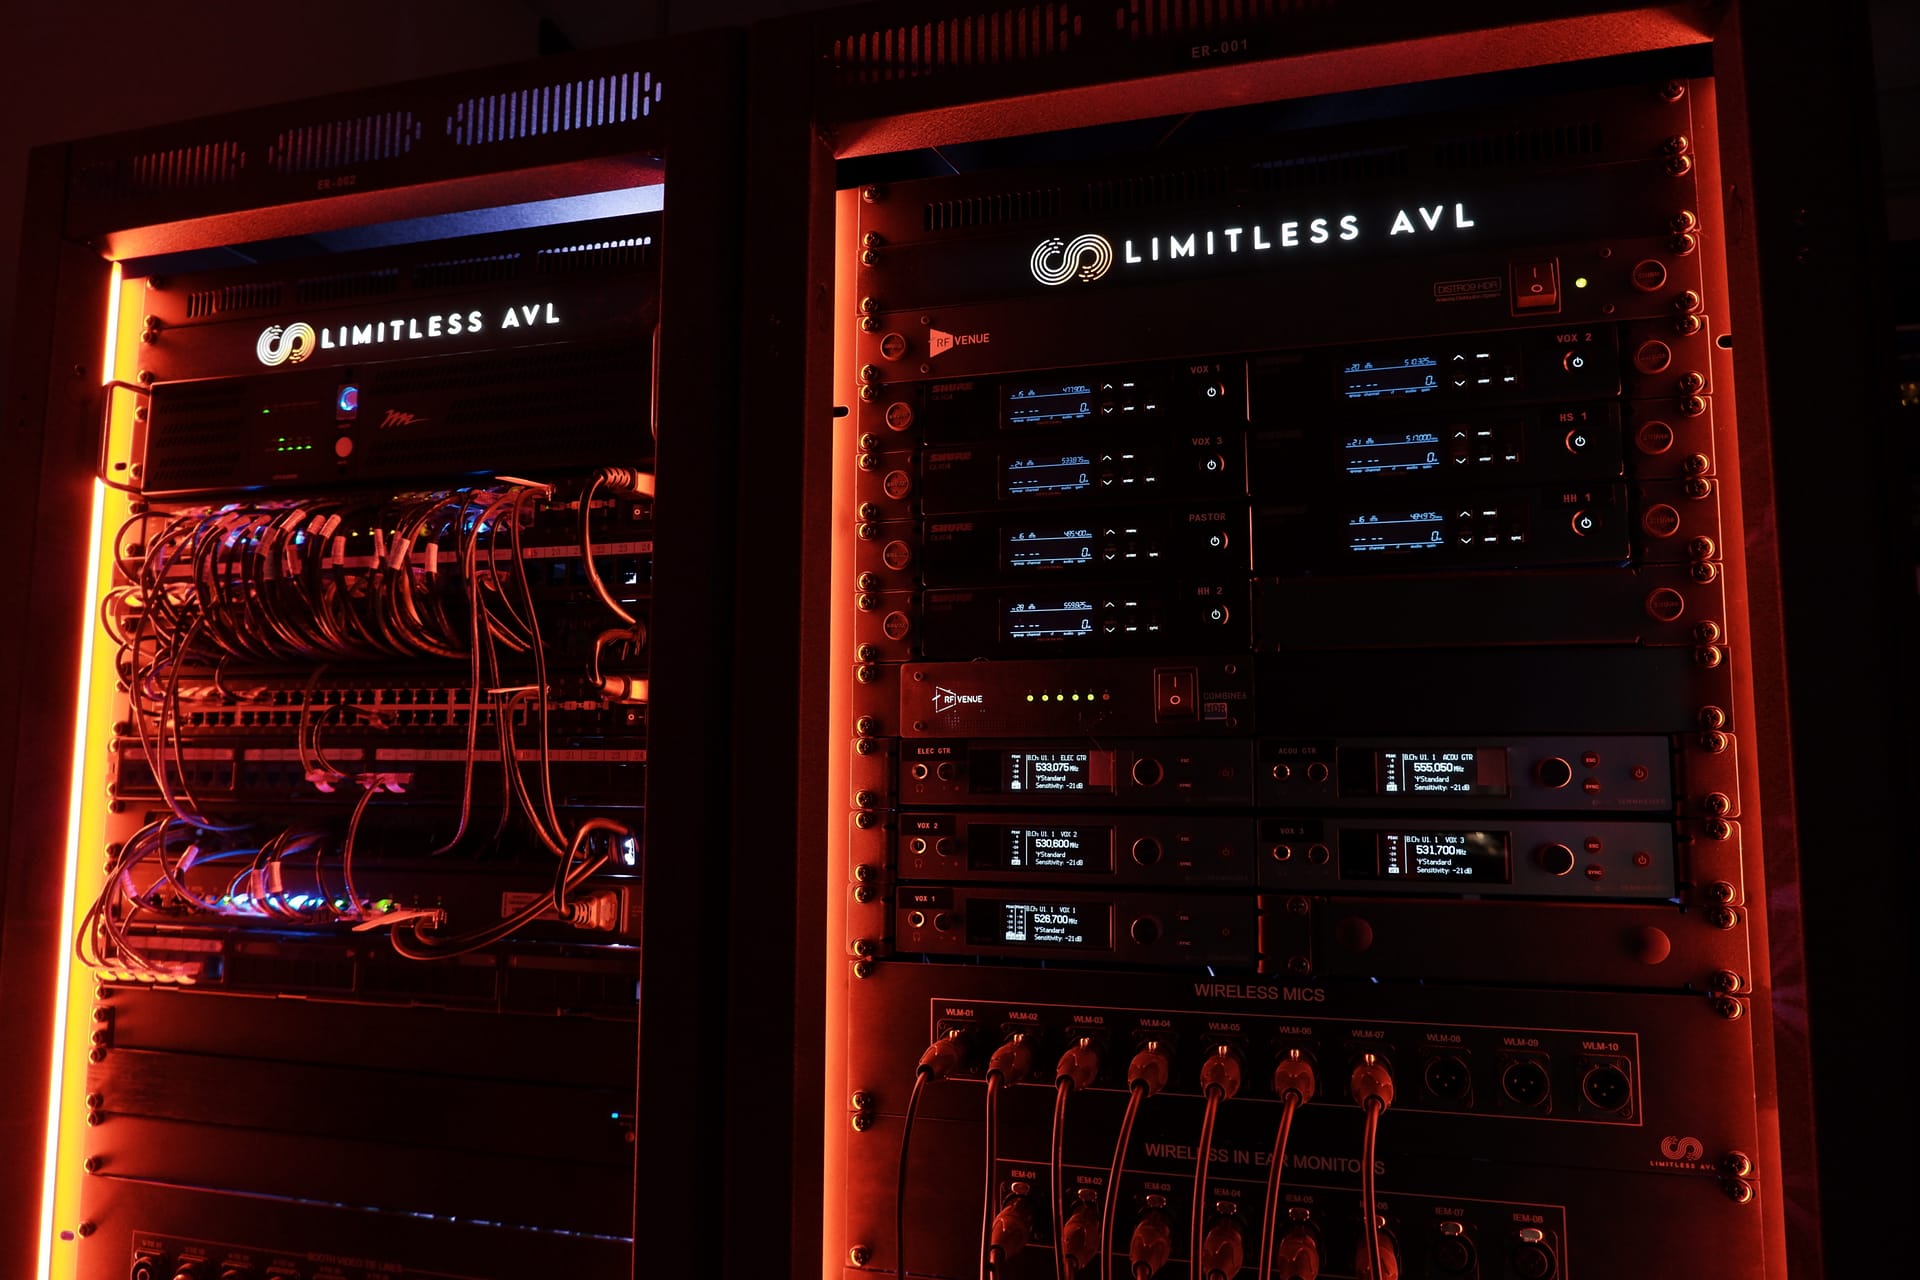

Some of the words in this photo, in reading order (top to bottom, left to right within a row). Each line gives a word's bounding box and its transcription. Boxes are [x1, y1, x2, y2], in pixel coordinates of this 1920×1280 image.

[1191, 37, 1247, 58] ER-001
[1125, 214, 1359, 264] LIMITLESS
[1390, 203, 1475, 236] AVL
[320, 310, 483, 349] LIMITLESS
[501, 302, 560, 329] AVL
[936, 338, 950, 347] RF
[954, 333, 991, 346] VENUE
[1556, 332, 1578, 343] VOX
[1584, 332, 1592, 341] 2
[1190, 365, 1208, 375] VOX
[1560, 412, 1575, 422] HS
[1192, 436, 1210, 446] VOX
[1216, 436, 1223, 445] 3
[1563, 493, 1577, 503] HH
[1189, 512, 1226, 522] PASTOR
[1197, 586, 1210, 596] HH
[1216, 586, 1223, 595] 2
[944, 695, 955, 703] RF
[957, 695, 983, 703] VENUE
[917, 747, 935, 755] ELEC
[917, 822, 931, 830] VOX
[933, 822, 939, 830] 2
[914, 895, 928, 903] VOX
[1040, 926, 1065, 934] Standard
[1193, 983, 1279, 1000] WIRELESS
[1283, 987, 1326, 1002] MICS
[945, 1007, 974, 1017] WLM-01
[1008, 1011, 1039, 1021] WLM-02
[1073, 1015, 1104, 1025] WLM-03
[1140, 1018, 1171, 1028] WLM-04
[1208, 1022, 1241, 1032] WLM-05
[1279, 1026, 1312, 1035] WLM-06
[1352, 1029, 1385, 1039] WLM-07
[1426, 1033, 1461, 1043] WLM-08
[1503, 1037, 1539, 1047] WLM-09
[1582, 1041, 1619, 1051] WLM-10
[1144, 1142, 1229, 1163] WIRELSS
[1234, 1149, 1250, 1165] IN
[1294, 1154, 1386, 1175] MONITOS
[1649, 1160, 1695, 1169] LIMITLESS
[1700, 1163, 1717, 1171] AVL
[1011, 1170, 1036, 1179] IEM-01
[1077, 1176, 1103, 1185] IEM-02
[1144, 1182, 1171, 1192] IEM-03
[1434, 1207, 1464, 1217] IEM-07
[1513, 1212, 1543, 1224] IEM-08
